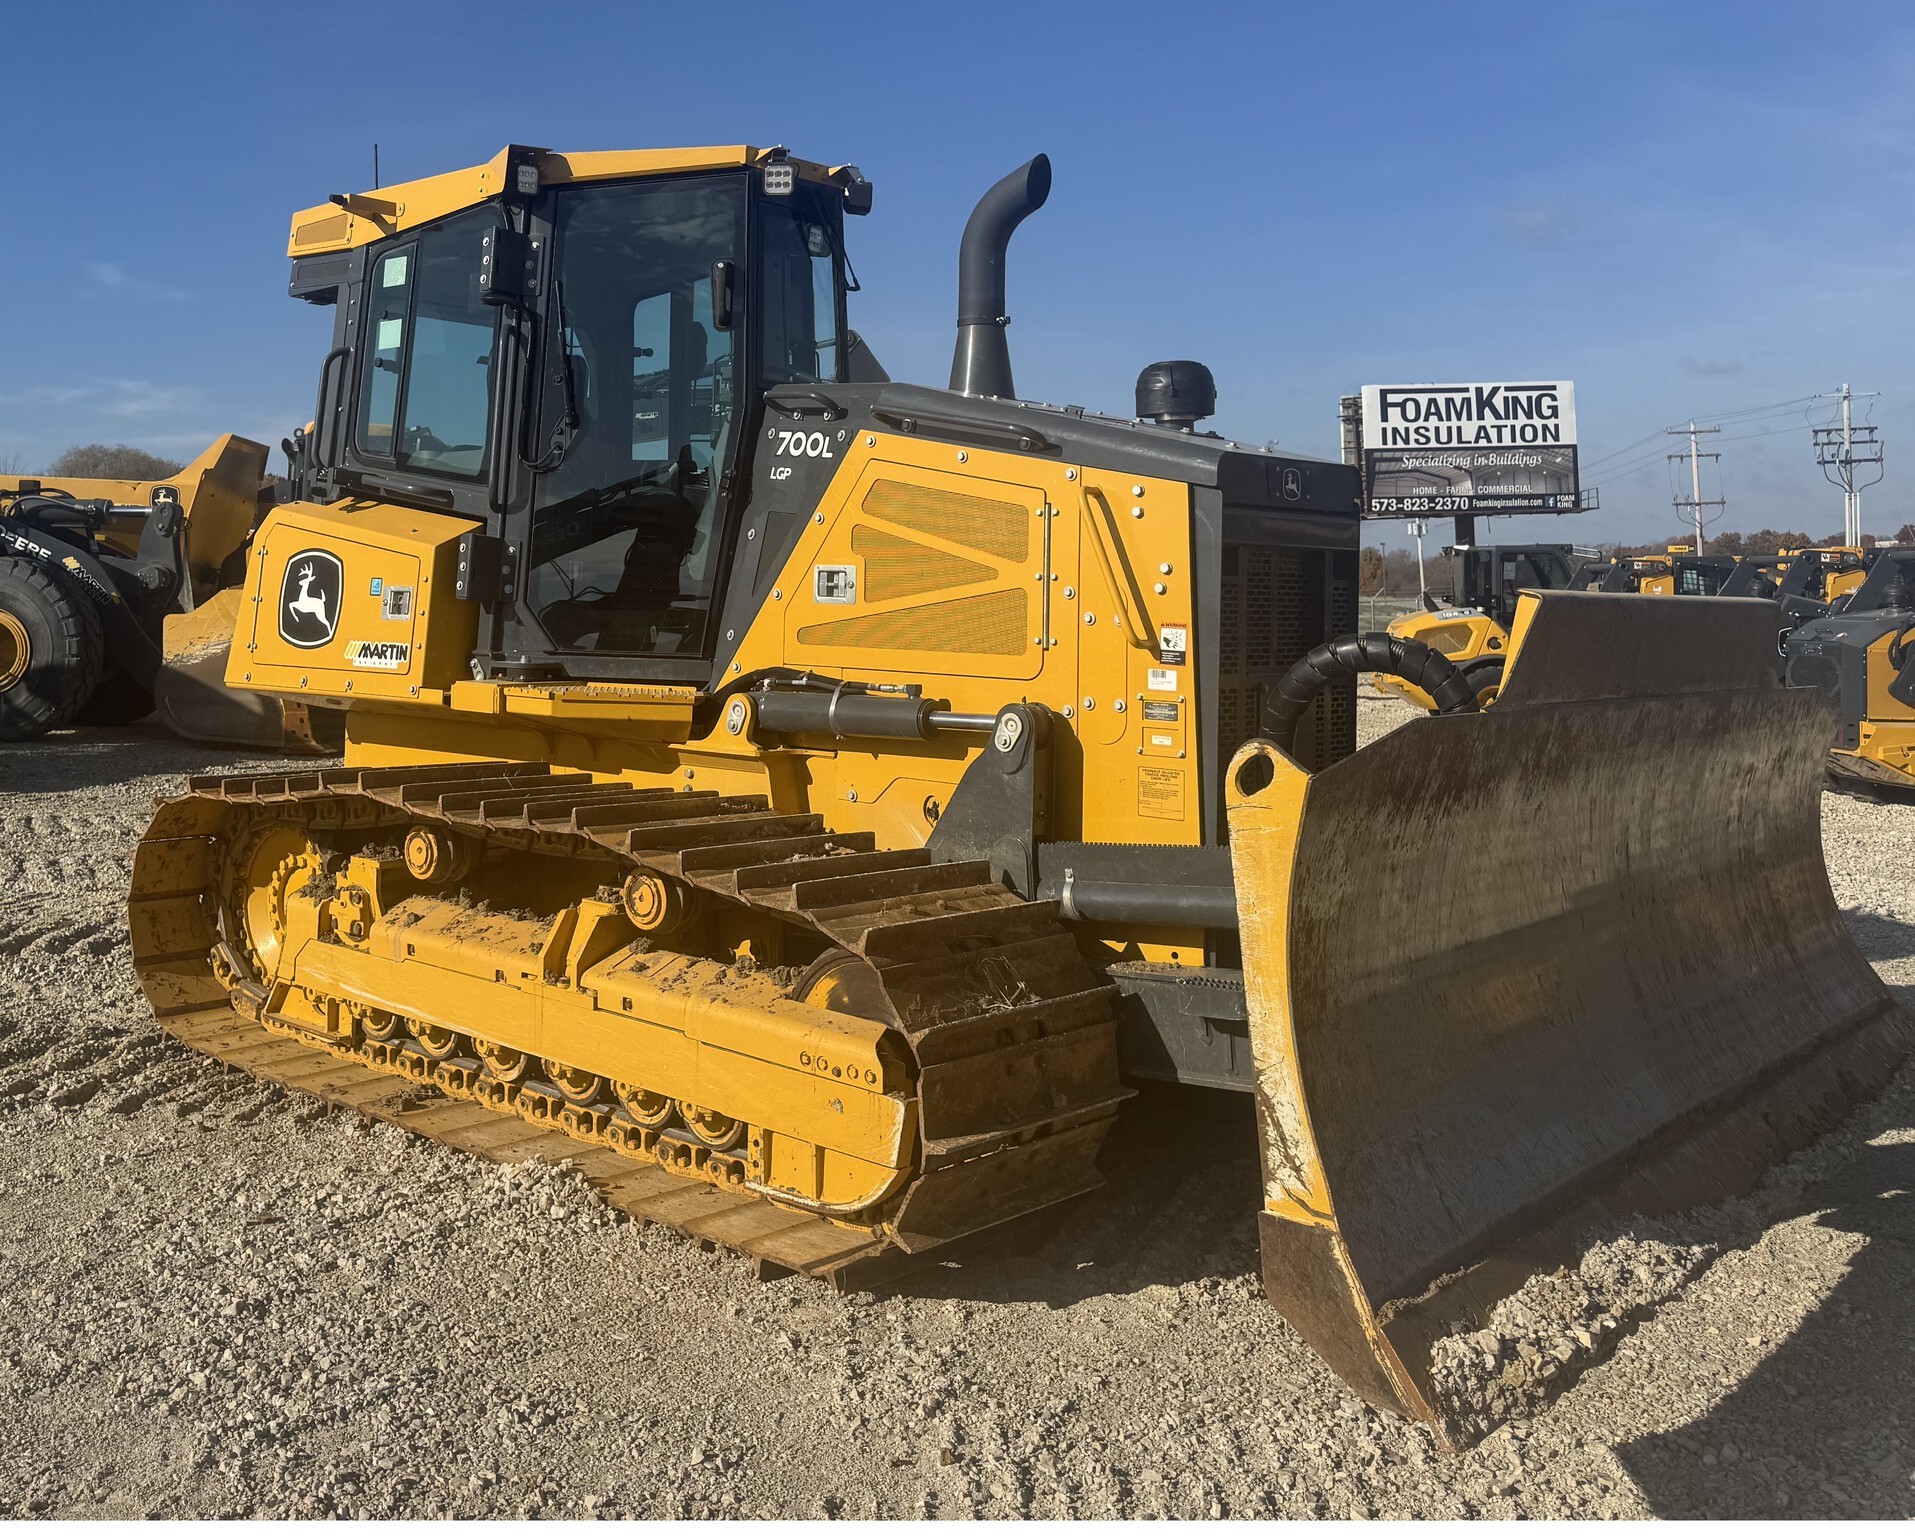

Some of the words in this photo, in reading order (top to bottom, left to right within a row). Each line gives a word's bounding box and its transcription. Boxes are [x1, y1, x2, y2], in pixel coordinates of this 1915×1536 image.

[1381, 423, 1560, 446] INSULATION
[776, 431, 833, 458] 700L
[1401, 454, 1471, 469] Specializing
[1474, 454, 1485, 466] in
[1488, 453, 1542, 467] Buildings
[770, 467, 792, 480] LGP
[1412, 486, 1438, 495] HOME
[1446, 486, 1469, 494] FARM
[1477, 485, 1533, 494] COMMERCIAL
[1371, 497, 1469, 512] 573-823-2370
[1472, 498, 1543, 508] Foamkinginsulation.com
[1557, 494, 1575, 502] FOAM
[358, 642, 408, 661] MARTIN
